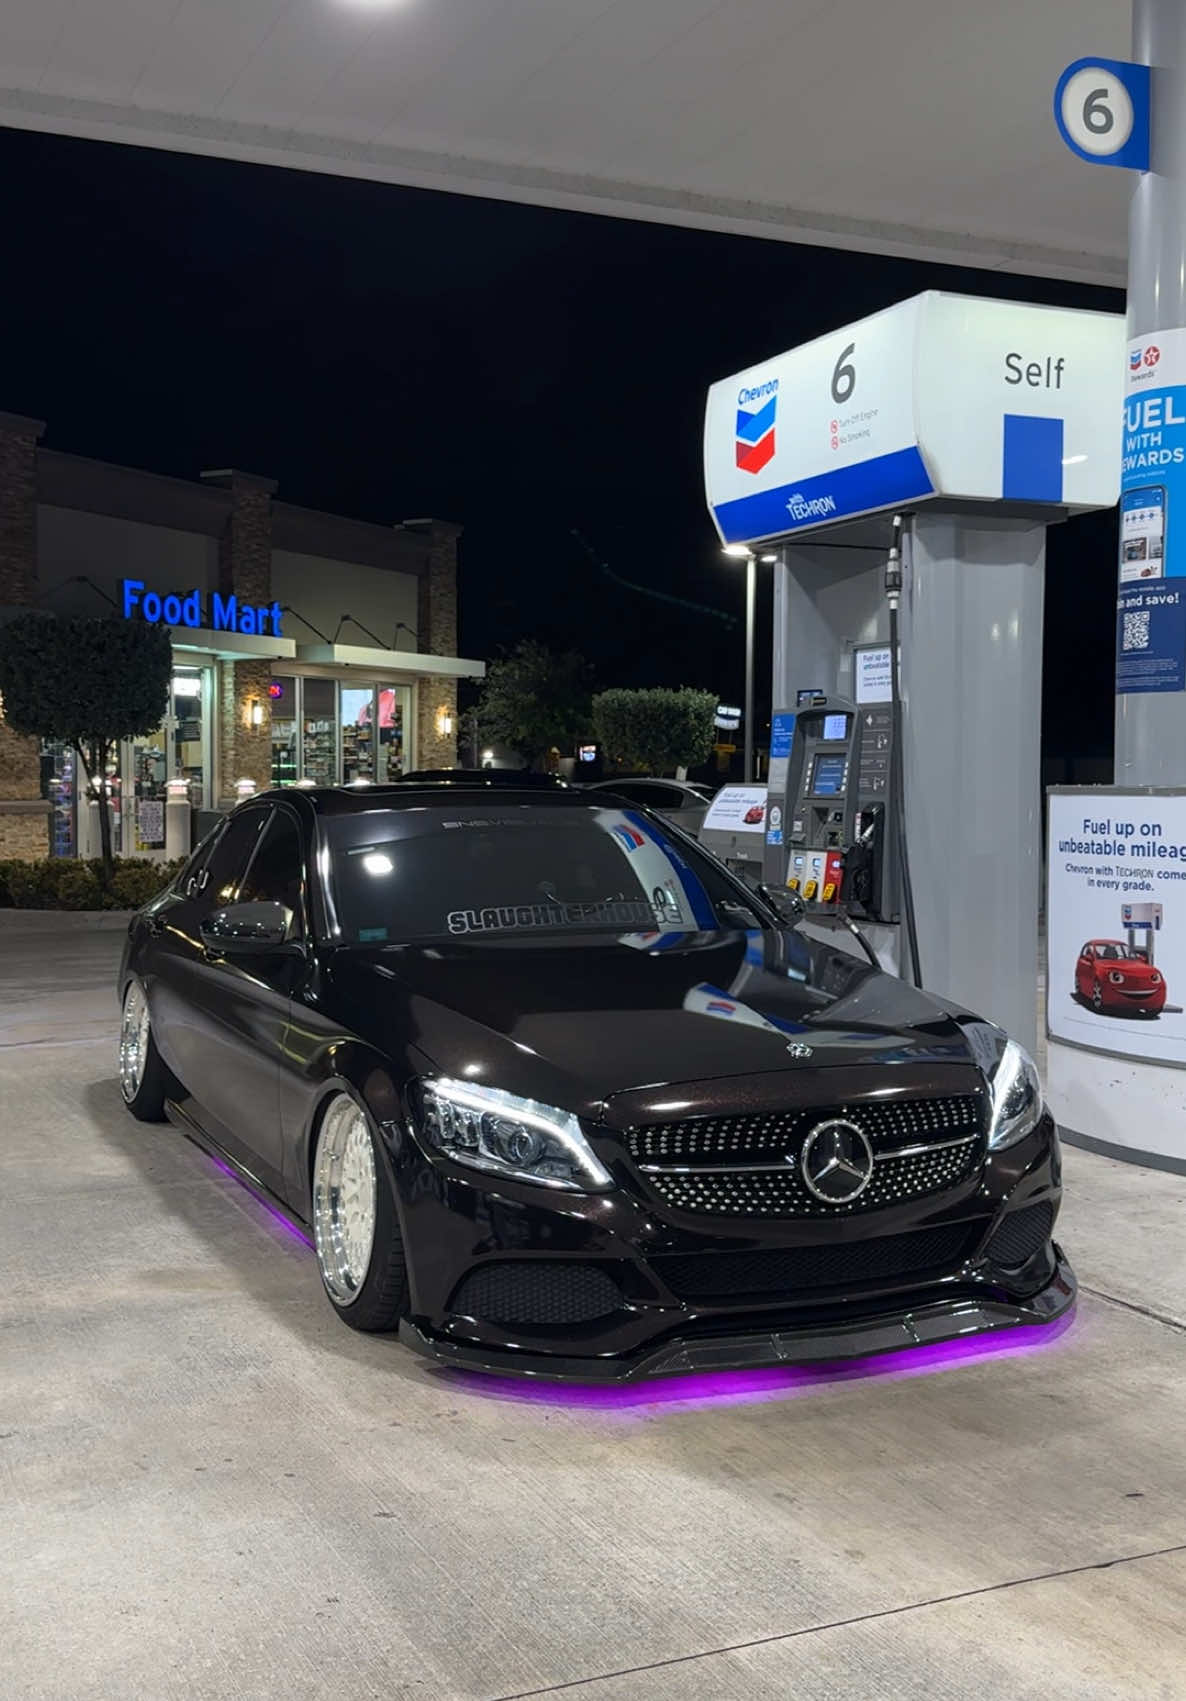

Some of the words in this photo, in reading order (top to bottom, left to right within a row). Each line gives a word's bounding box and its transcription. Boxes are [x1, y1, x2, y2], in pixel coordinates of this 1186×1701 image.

[1083, 88, 1114, 134] 6
[831, 342, 856, 404] 6
[1004, 352, 1065, 389] Self
[738, 379, 779, 405] Chevron
[1126, 431, 1162, 452] WITH
[785, 496, 836, 521] TECHRON
[123, 579, 200, 627] Food
[213, 591, 283, 637] Mart
[1145, 592, 1180, 605] save!
[1083, 819, 1110, 835] Fuel
[1115, 823, 1135, 839] up
[1139, 823, 1162, 837] on
[1059, 838, 1126, 856] unbeatable
[1065, 863, 1094, 875] Chevron
[1095, 864, 1114, 876] with
[1115, 866, 1154, 879] TECHRON
[1087, 877, 1095, 887] in
[1096, 879, 1120, 890] every
[1122, 881, 1155, 892] grade.
